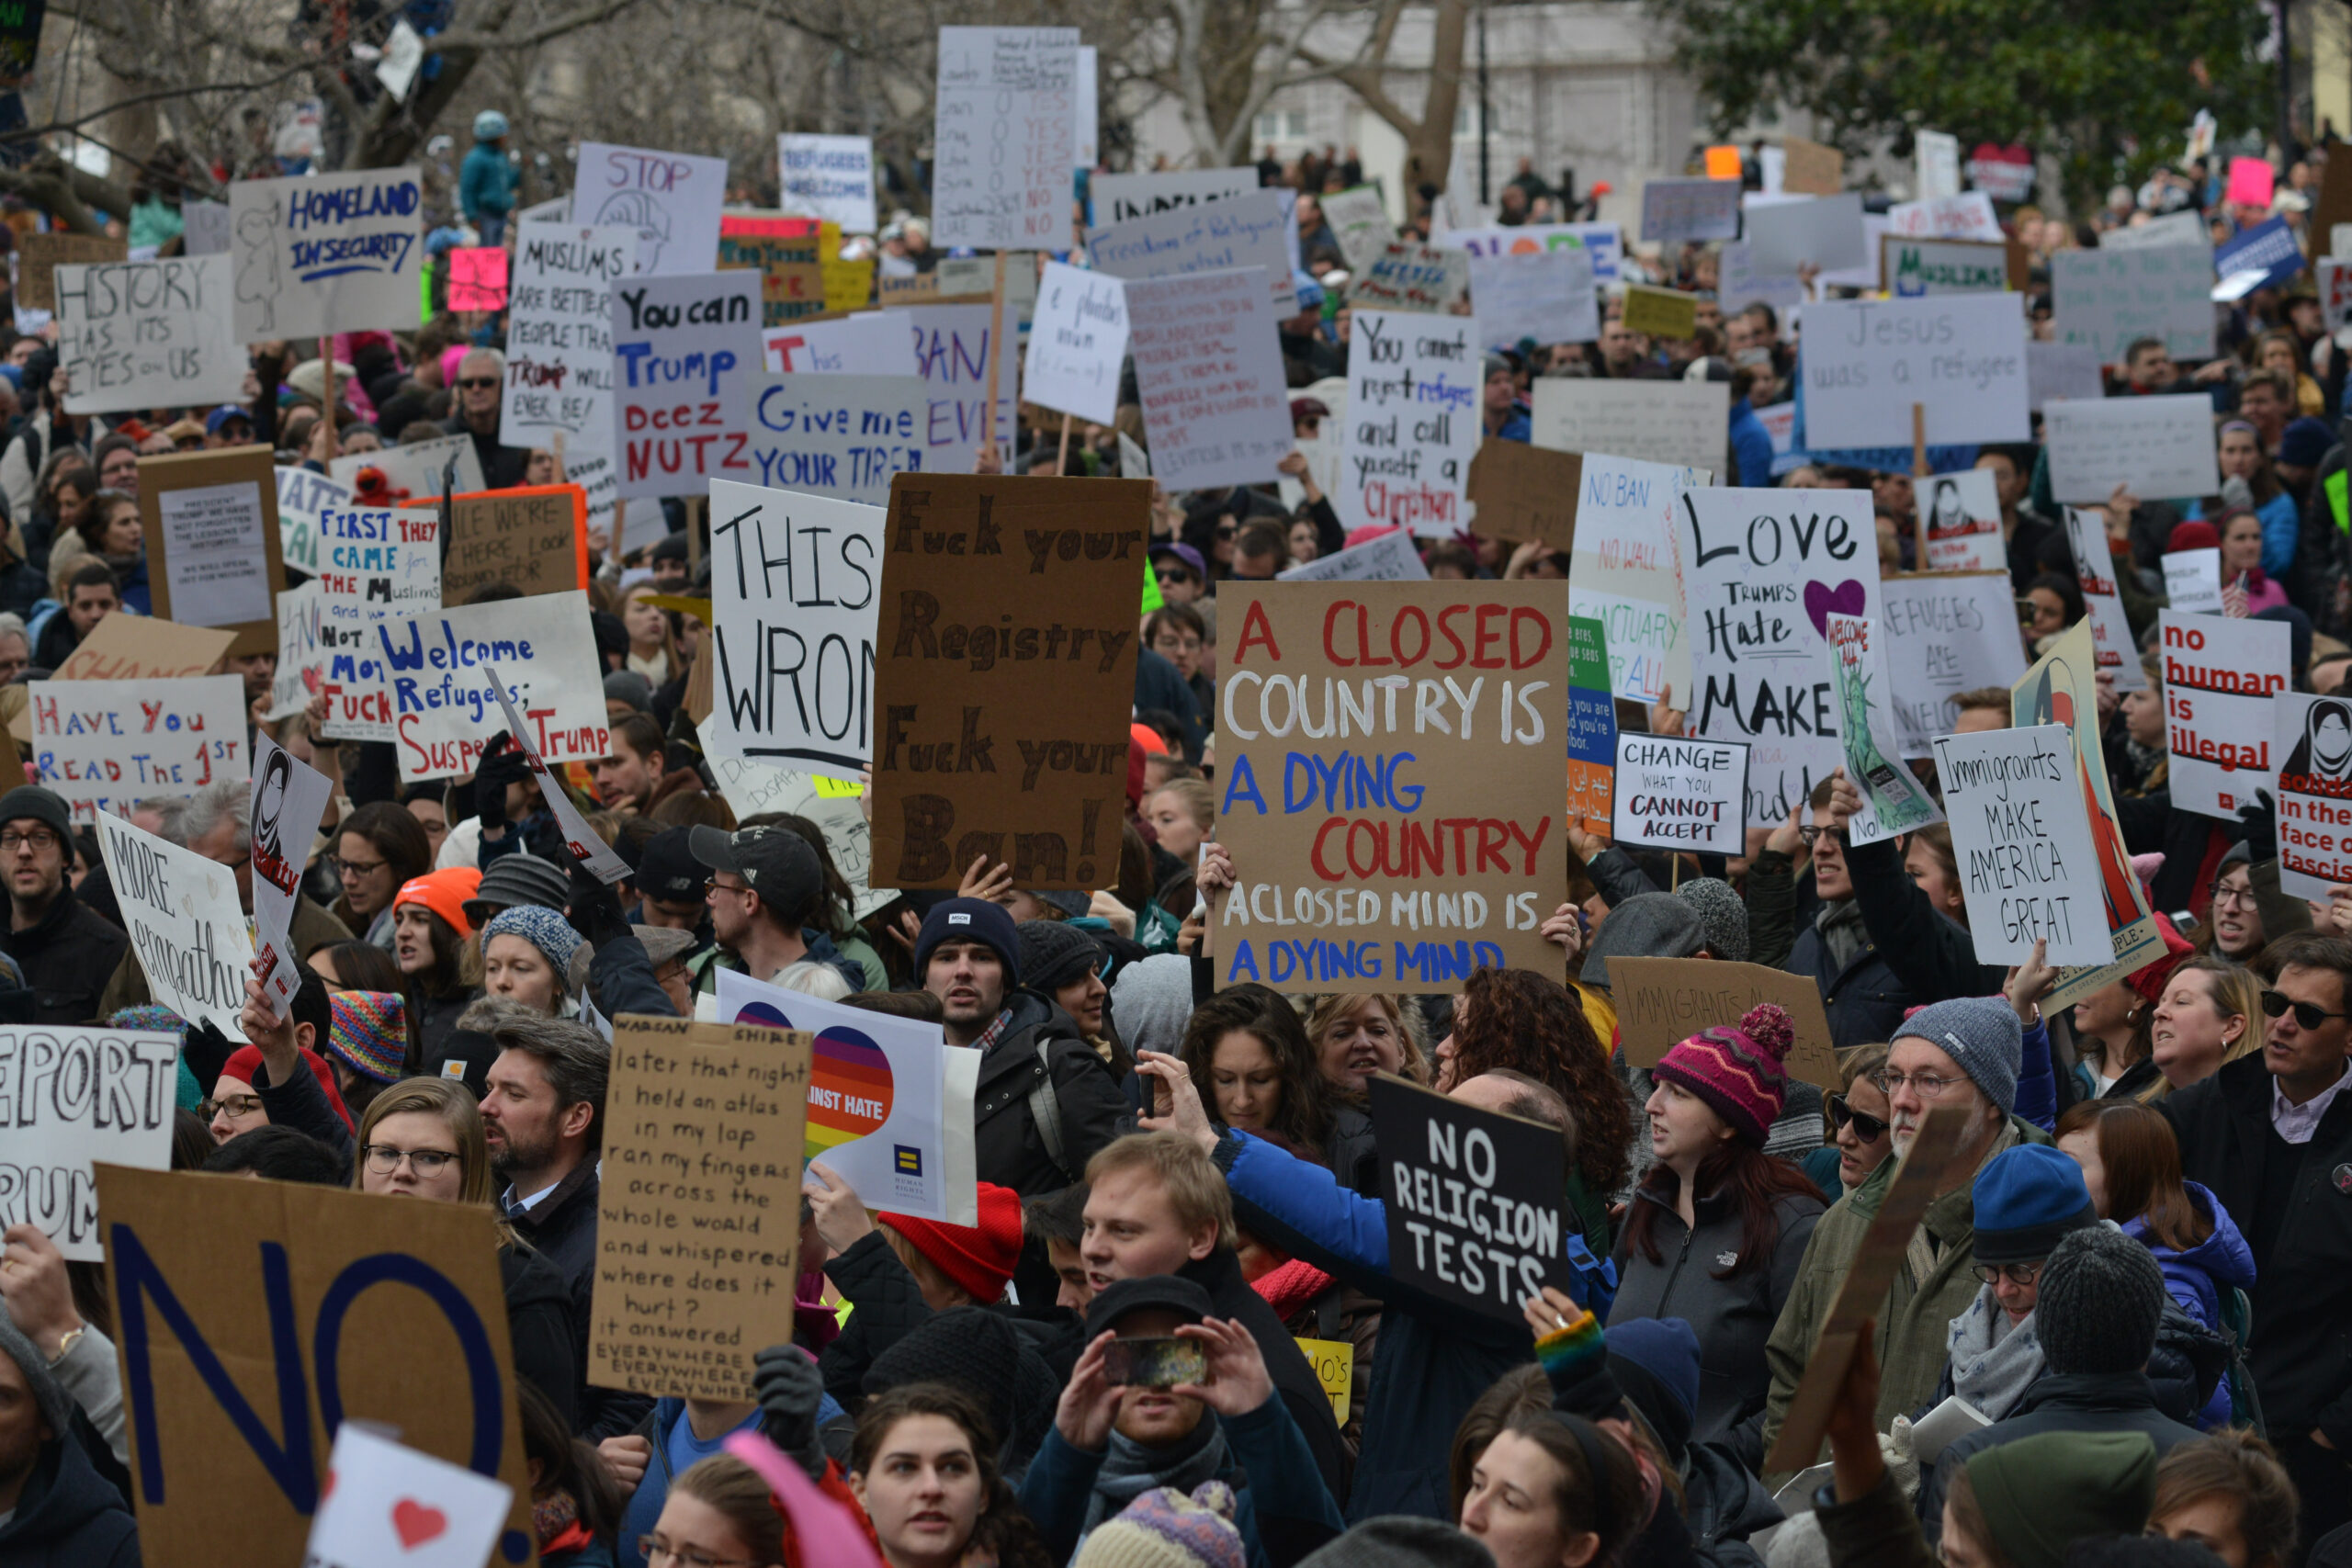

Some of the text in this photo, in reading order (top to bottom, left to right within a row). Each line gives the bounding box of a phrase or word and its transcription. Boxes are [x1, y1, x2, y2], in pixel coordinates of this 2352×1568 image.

[1030, 91, 1068, 110] YES
[1024, 117, 1068, 137] YES
[1023, 143, 1071, 161] YES
[607, 152, 691, 192] STOP
[1023, 166, 1069, 186] YES
[288, 180, 420, 230] HOMELAND
[1025, 189, 1051, 209] NO
[1024, 214, 1053, 236] NO
[290, 231, 415, 274] INSECURITY
[1090, 233, 1179, 265] Freedom
[58, 261, 208, 319] HISTORY
[511, 285, 612, 319] ARE BETTER
[620, 288, 749, 330] You can
[1847, 303, 1954, 346] Jesus
[61, 315, 172, 355] HAS ITS
[511, 321, 570, 349] PEOPLE
[1358, 317, 1466, 365] You cannot
[66, 347, 200, 398] EYES US
[508, 354, 614, 390] TRUMP WILL
[616, 342, 736, 397] Trump
[1362, 368, 1412, 405] reject
[1812, 349, 2018, 390] was a refugee
[514, 394, 550, 418] EVER
[758, 385, 912, 437] Give me
[1358, 413, 1451, 446] and call
[628, 432, 750, 482] NUTZ
[754, 447, 837, 487] YOUR
[1354, 450, 1458, 489] yourself a
[1364, 479, 1456, 525] Christian
[1588, 473, 1651, 508] NO BAN
[321, 509, 438, 543] FIRST THEY
[893, 490, 1143, 574] Fuck your
[333, 547, 428, 578] CAME for
[714, 505, 874, 611] THIS
[1597, 539, 1657, 571] NO WALL
[321, 573, 440, 603] THE Muslims
[332, 604, 358, 619] and
[322, 626, 363, 648] NOT
[378, 619, 534, 671] Welcome
[892, 590, 1132, 673] Registry
[1234, 600, 1553, 670] A CLOSED
[1704, 606, 1792, 662] Hate
[1827, 618, 1869, 651] WELCOME
[2165, 625, 2205, 651] no
[1582, 647, 1599, 662] seas
[1927, 644, 1958, 672] ARE
[1624, 655, 1662, 697] ALL
[2166, 656, 2286, 695] human
[34, 695, 124, 735] HAVE
[323, 684, 393, 724] FUCK
[1223, 671, 1550, 744] COUNTRY IS
[1575, 698, 1610, 716] you are
[1700, 672, 1838, 737] MAKE
[2168, 690, 2193, 720] is
[526, 708, 608, 757] Trump
[1579, 718, 1608, 736] you're
[39, 751, 121, 782] READ
[881, 705, 1128, 792] Fuck your
[1624, 743, 1730, 771] CHANGE
[2171, 725, 2268, 772] illegal
[1222, 750, 1426, 815] A DYING
[1642, 773, 1712, 794] WHAT YOU
[1934, 737, 2062, 801] Immigrants
[1630, 794, 1728, 821] CANNOT
[1984, 800, 2047, 843] MAKE
[2279, 795, 2351, 827] in the
[897, 793, 1102, 884] Ban!
[1311, 816, 1551, 881] COUNTRY
[1643, 821, 1717, 841] ACCEPT
[2279, 822, 2334, 851] face
[109, 827, 175, 919] MORE
[1971, 841, 2067, 894] AMERICA
[1390, 889, 1488, 931] MIND
[1506, 891, 1540, 931] IS
[2001, 897, 2073, 946] GREAT
[1227, 937, 1505, 982] A DYING MIND
[1621, 970, 1742, 1027] IMMIGRANTS
[613, 1019, 689, 1035] WARSAN
[616, 1047, 807, 1089] later that night
[614, 1085, 779, 1116] i held an atlas
[845, 1095, 884, 1120] HATE
[635, 1120, 755, 1151] in my lap
[608, 1145, 689, 1176] ran my
[1428, 1119, 1498, 1190] NO
[629, 1179, 770, 1209] across the
[895, 1177, 923, 1187] HUMAN
[895, 1185, 924, 1194] RIGHTS
[603, 1206, 679, 1229] whole
[1394, 1160, 1559, 1259] RELIGION
[605, 1239, 790, 1269] and whispered
[1406, 1221, 1547, 1313] TESTS
[602, 1269, 775, 1295] where does it
[600, 1316, 741, 1346] it answered
[595, 1343, 743, 1369] EVERYWHERE
[612, 1359, 754, 1385] EVERYWHERE
[628, 1377, 758, 1400] EVERYWHER
